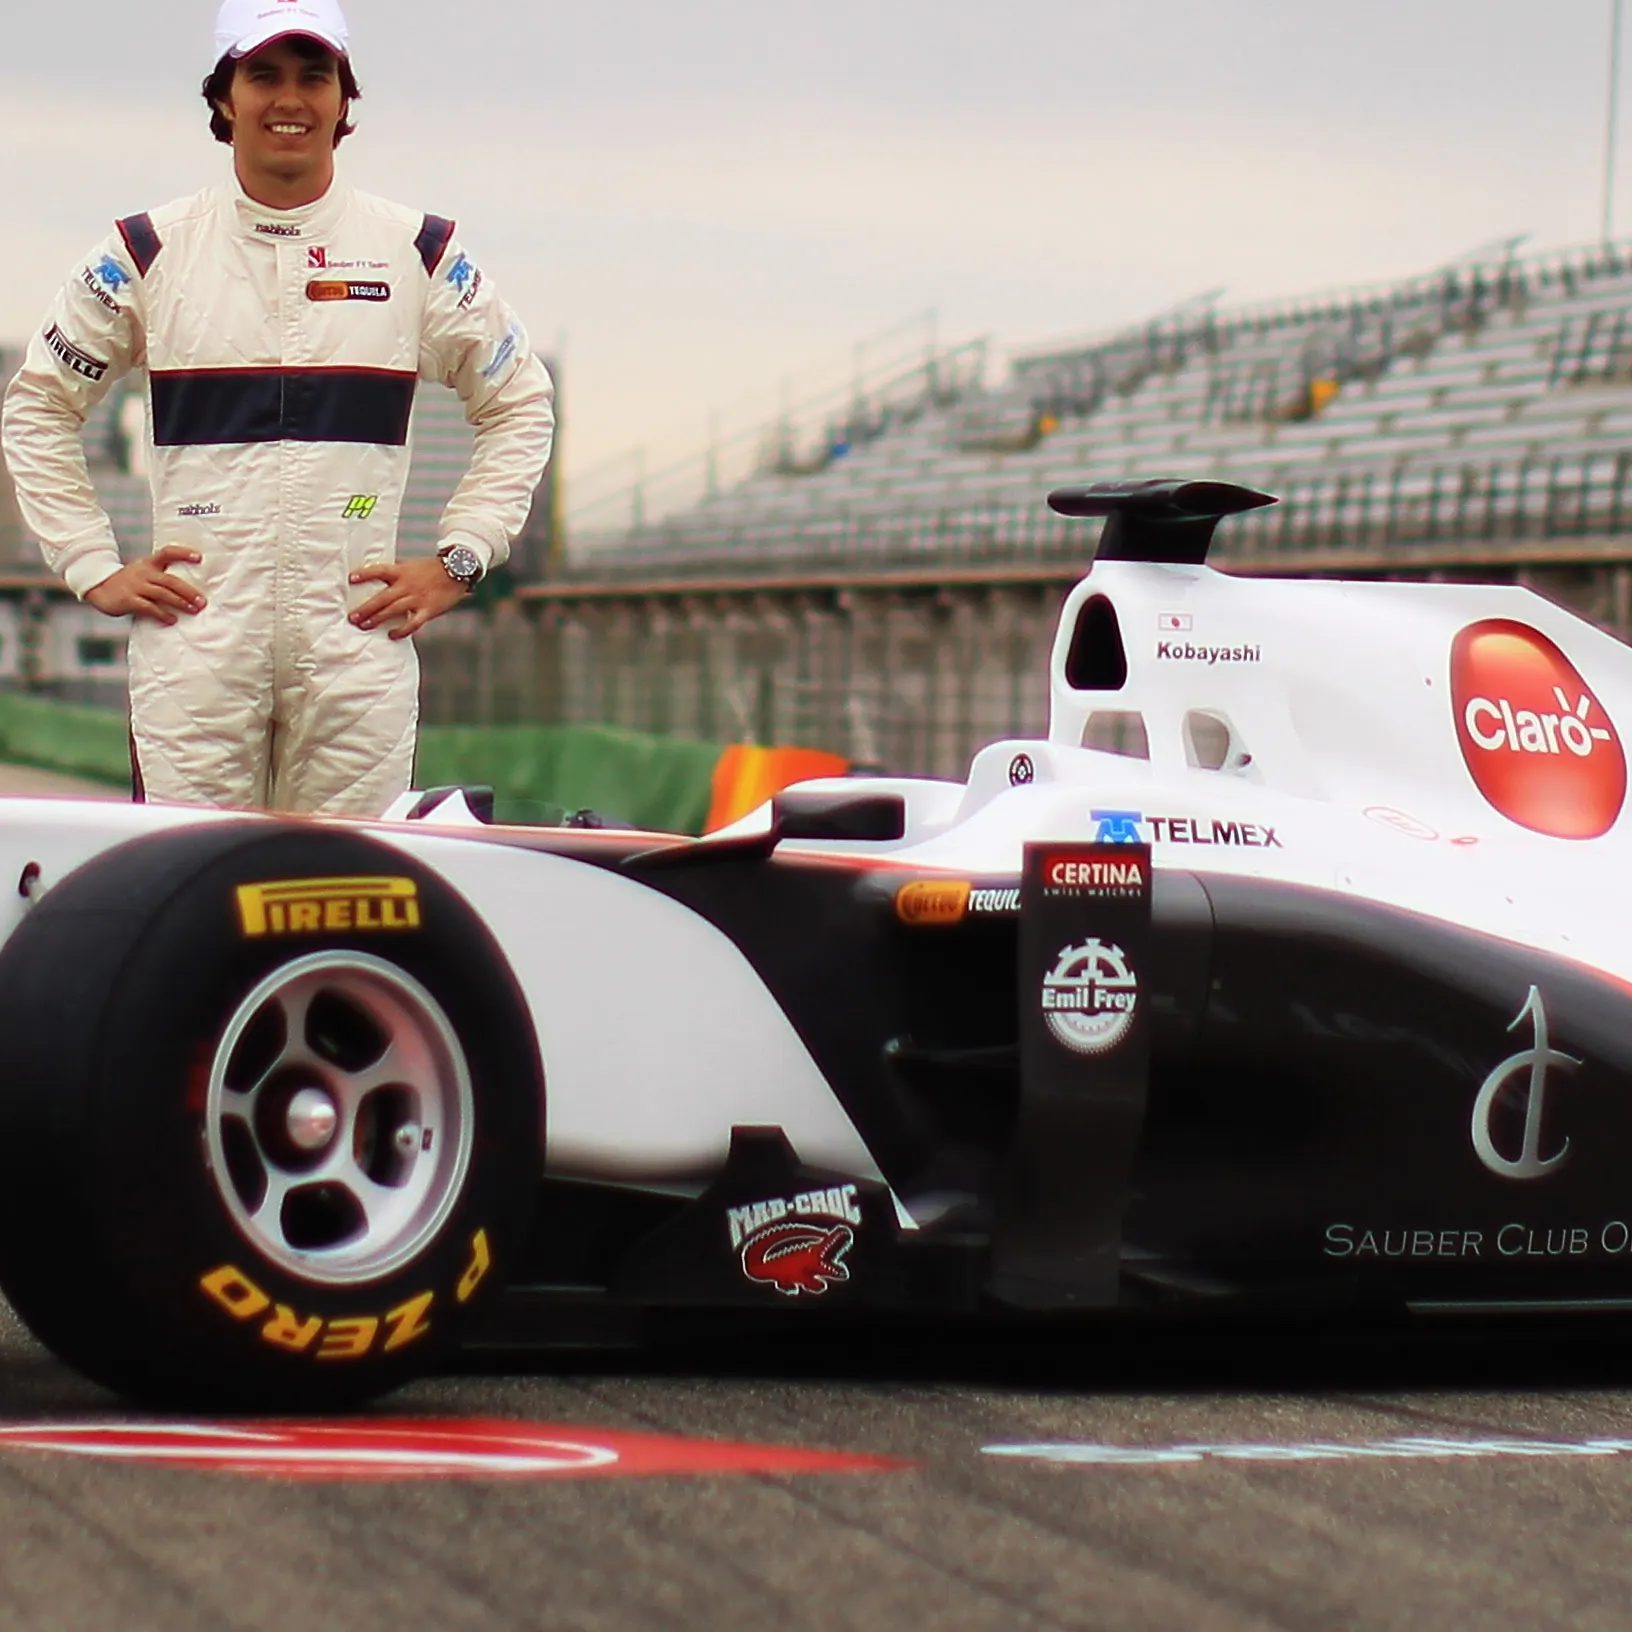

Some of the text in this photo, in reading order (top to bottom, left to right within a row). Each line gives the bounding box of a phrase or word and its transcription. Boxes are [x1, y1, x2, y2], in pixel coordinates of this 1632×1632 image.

[81, 265, 122, 315] TELMEX
[349, 286, 387, 298] TEQUILA
[44, 323, 109, 382] PIRELLI
[1156, 640, 1261, 665] Kobayashi
[1464, 697, 1610, 758] Claro
[1145, 815, 1285, 850] TELMEX
[1052, 863, 1142, 885] CERTINA
[236, 875, 421, 938] PIRELLI
[968, 889, 1022, 912] TEQUIL
[1042, 988, 1137, 1014] Emil Frey
[198, 1263, 435, 1359] ZERO
